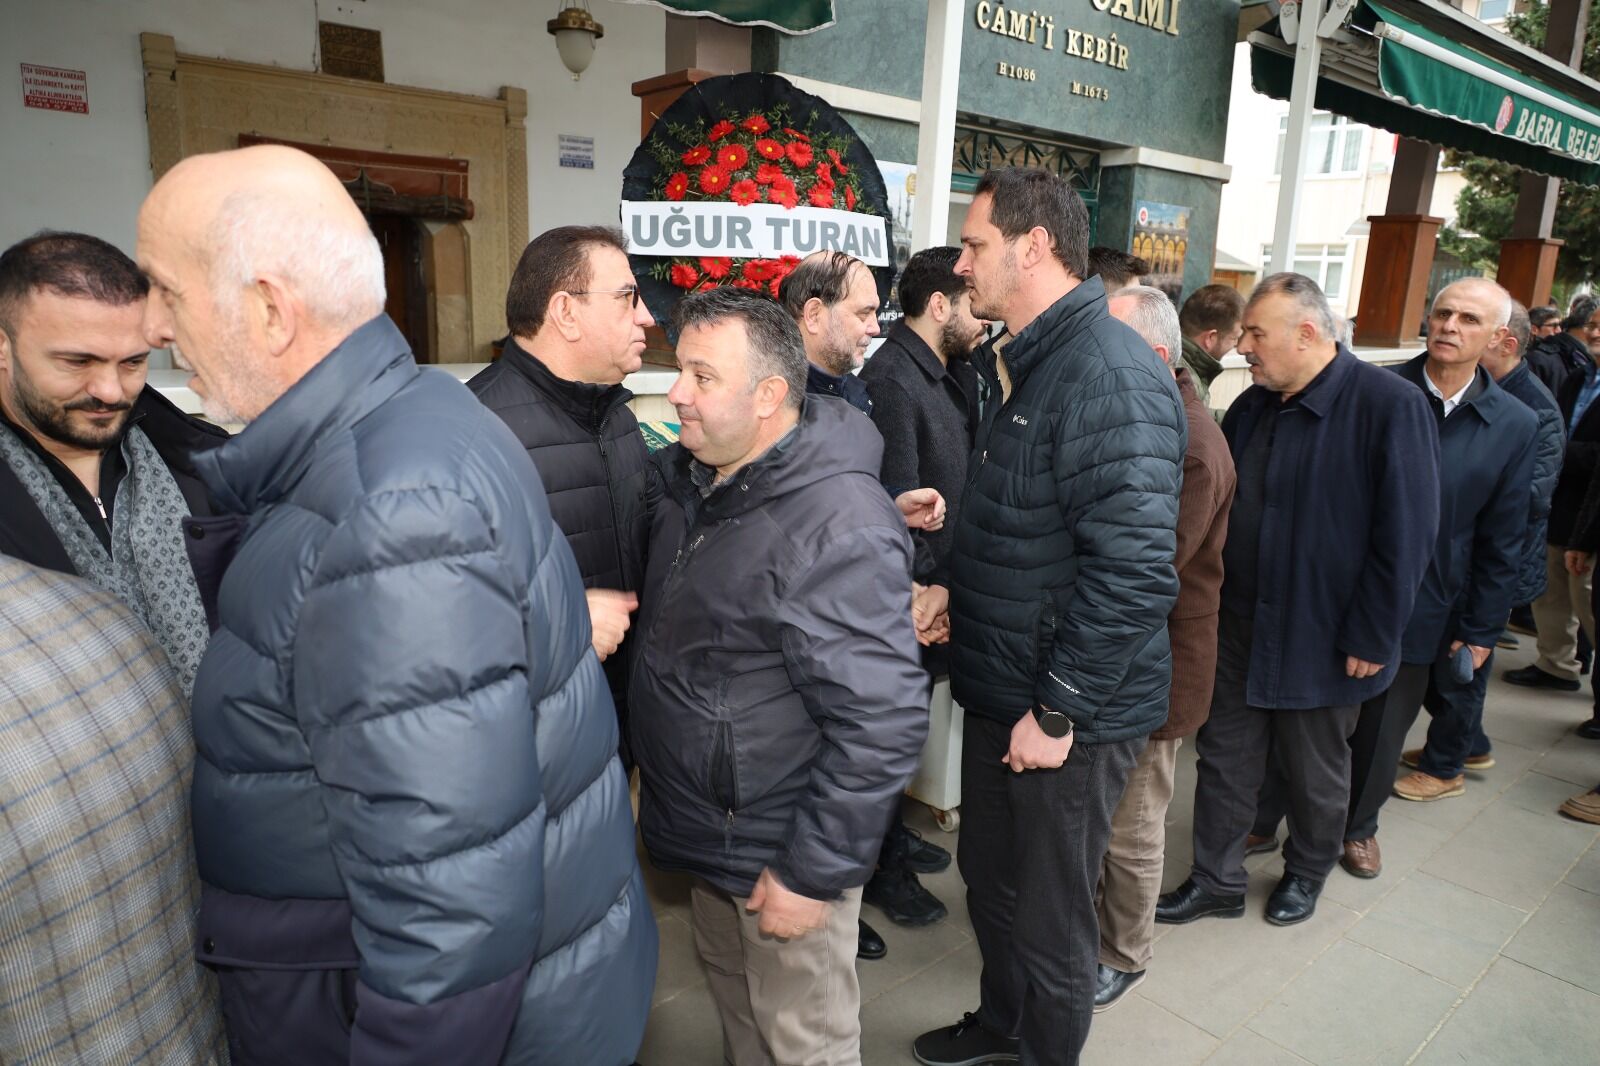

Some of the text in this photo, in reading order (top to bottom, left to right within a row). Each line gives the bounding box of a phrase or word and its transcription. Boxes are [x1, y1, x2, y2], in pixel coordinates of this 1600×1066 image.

[1515, 108, 1563, 150] BAFRA
[631, 206, 882, 258] UĞUR TURAN
